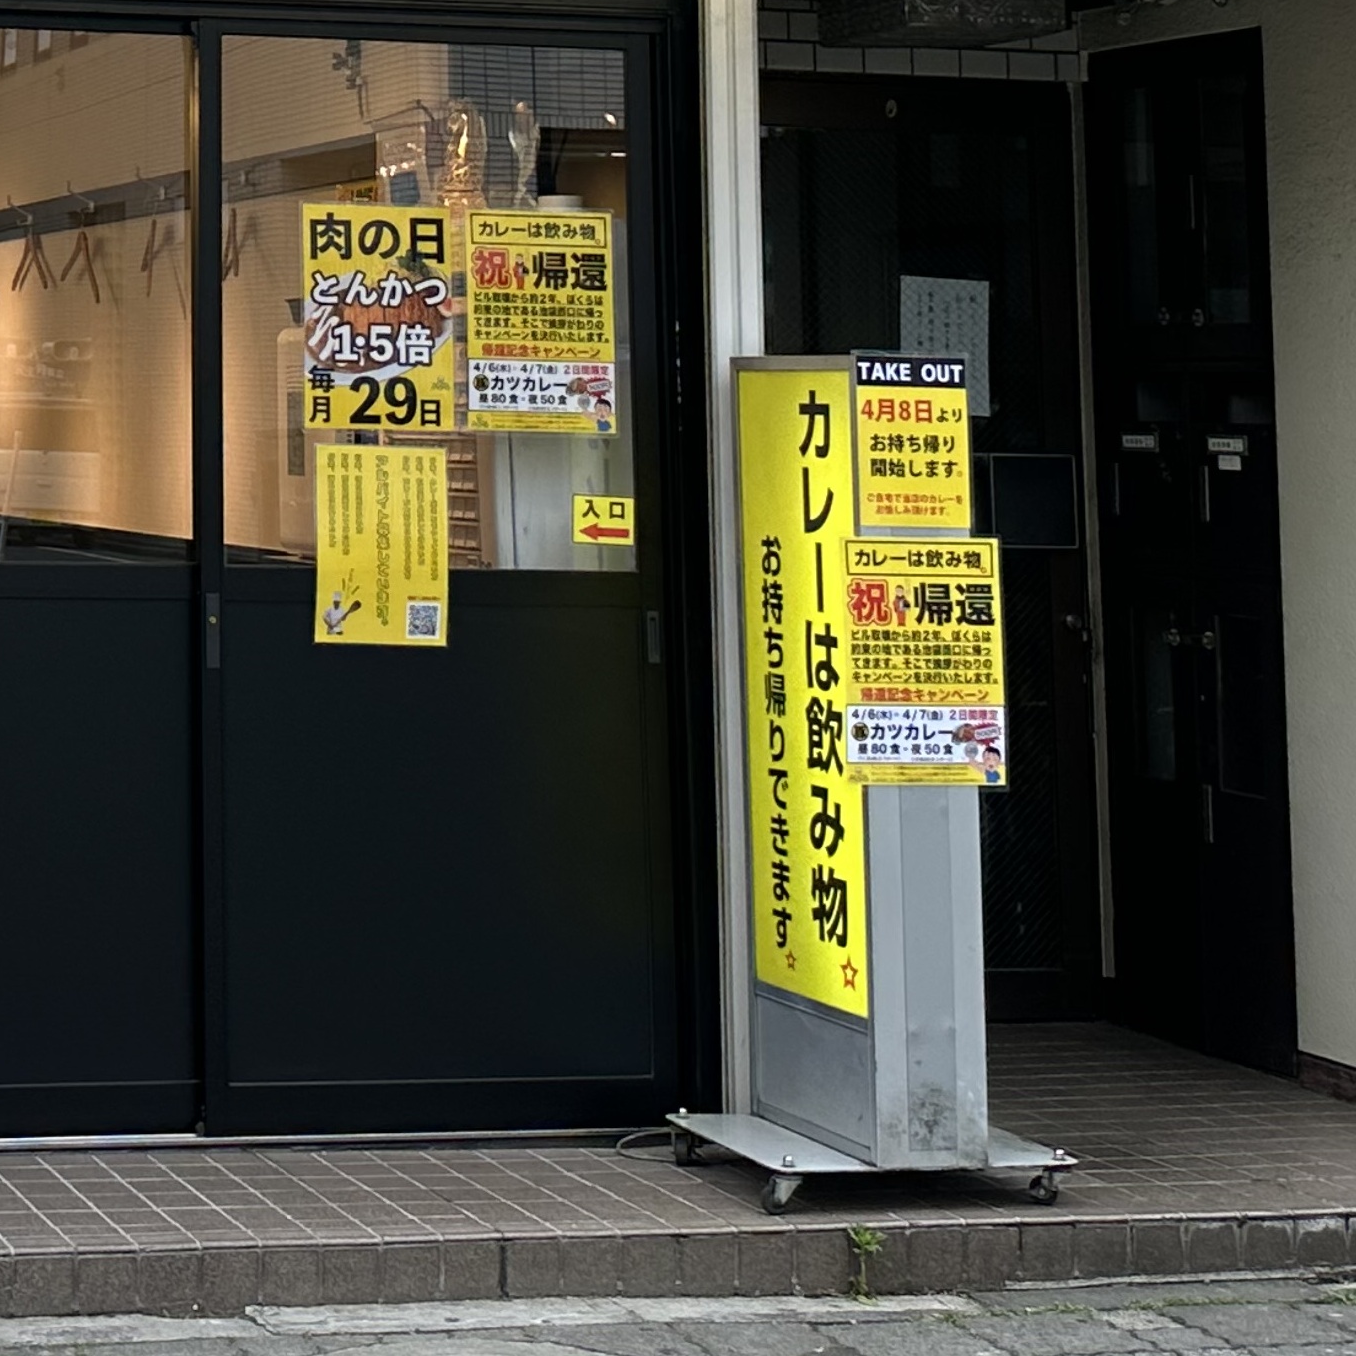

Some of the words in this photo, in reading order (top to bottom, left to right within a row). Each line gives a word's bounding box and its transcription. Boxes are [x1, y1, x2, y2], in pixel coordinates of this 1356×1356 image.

[310, 212, 445, 263] 肉の日
[478, 221, 601, 245] カレーは飲み物。
[471, 246, 512, 290] 祝
[532, 251, 607, 291] 帰還
[311, 270, 448, 307] とんかつ
[857, 362, 911, 381] TAKE
[921, 364, 963, 383] OUT
[308, 364, 336, 423] 毎月
[349, 375, 441, 427] 29日
[861, 398, 962, 423] 4月8日より
[870, 433, 955, 454] お持ち帰り
[870, 458, 963, 478] 開始します。
[582, 499, 625, 519] 入口
[854, 549, 987, 573] カレーは飲み物。
[847, 578, 892, 627] 祝
[913, 582, 995, 626] 帰還
[798, 390, 848, 948] カレーは飲み物
